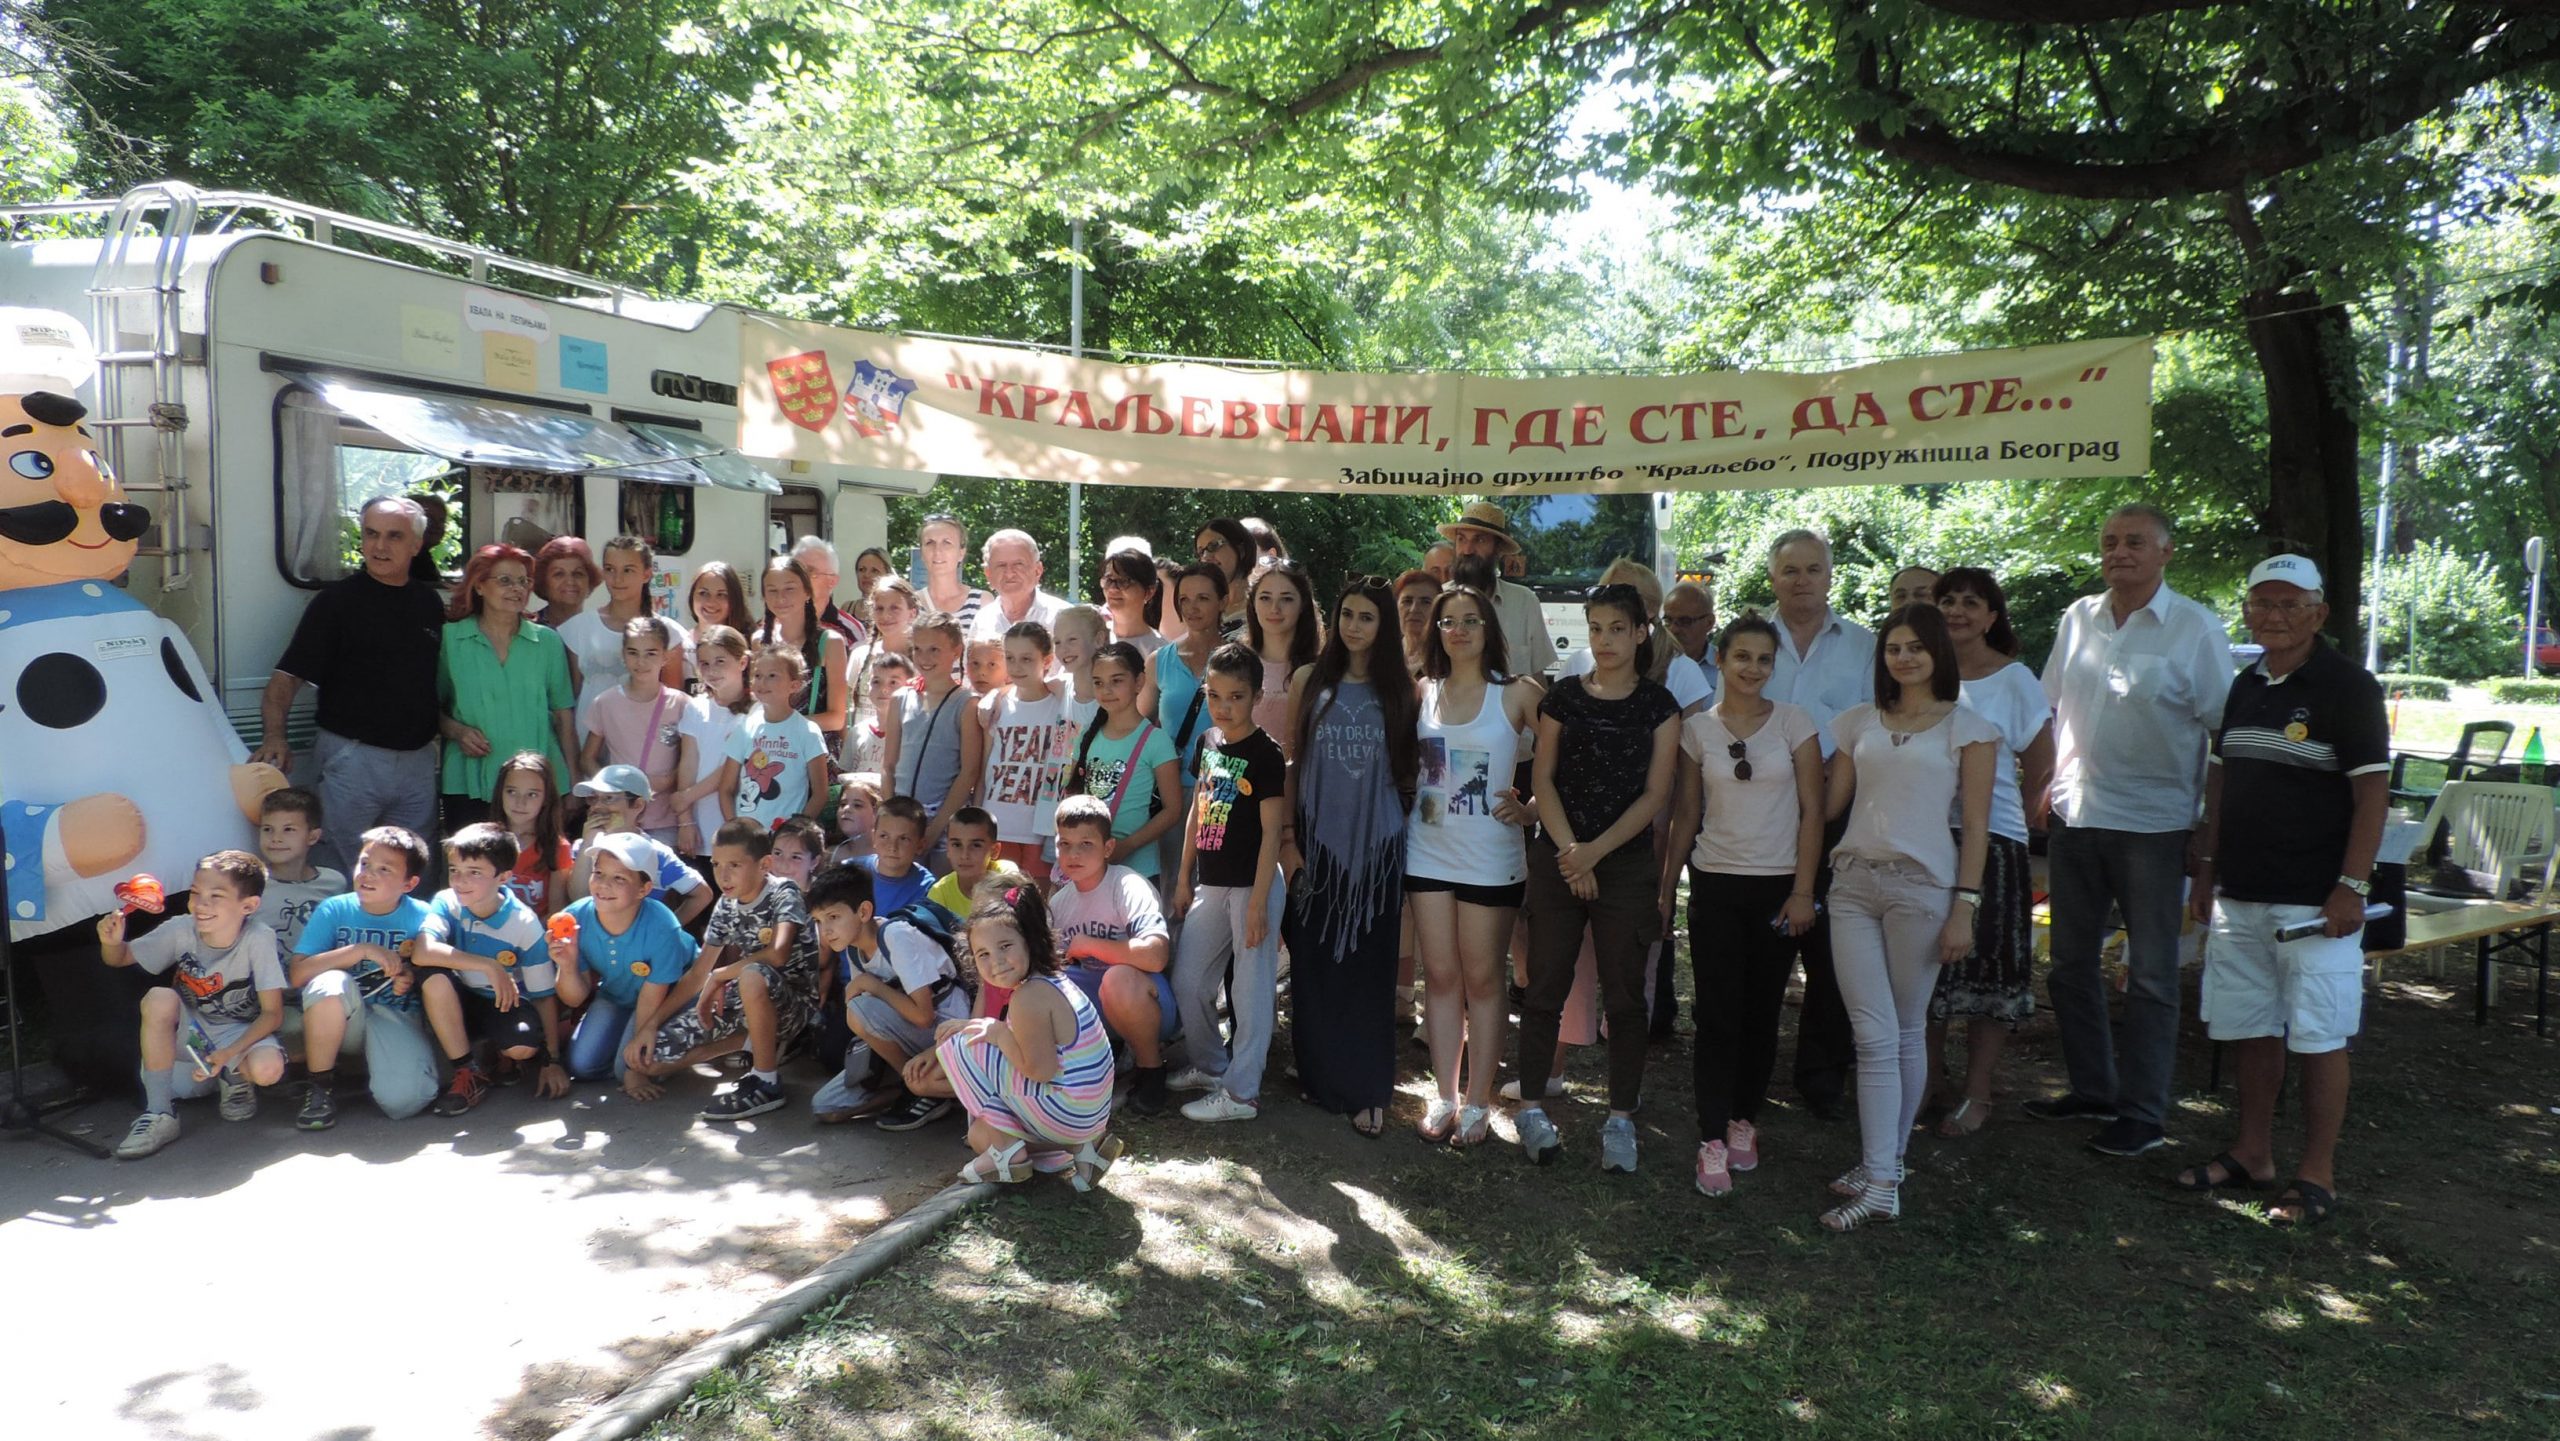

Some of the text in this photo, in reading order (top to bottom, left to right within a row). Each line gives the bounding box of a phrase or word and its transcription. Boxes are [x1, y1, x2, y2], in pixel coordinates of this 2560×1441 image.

[945, 372, 1450, 452] "КРАЉЕВЧАНИ,
[1471, 404, 1607, 455] ГДЕ
[1789, 391, 1889, 440] ДА
[1999, 440, 2121, 463] Београд
[752, 735, 790, 750] Minnie
[768, 749, 798, 760] mouse
